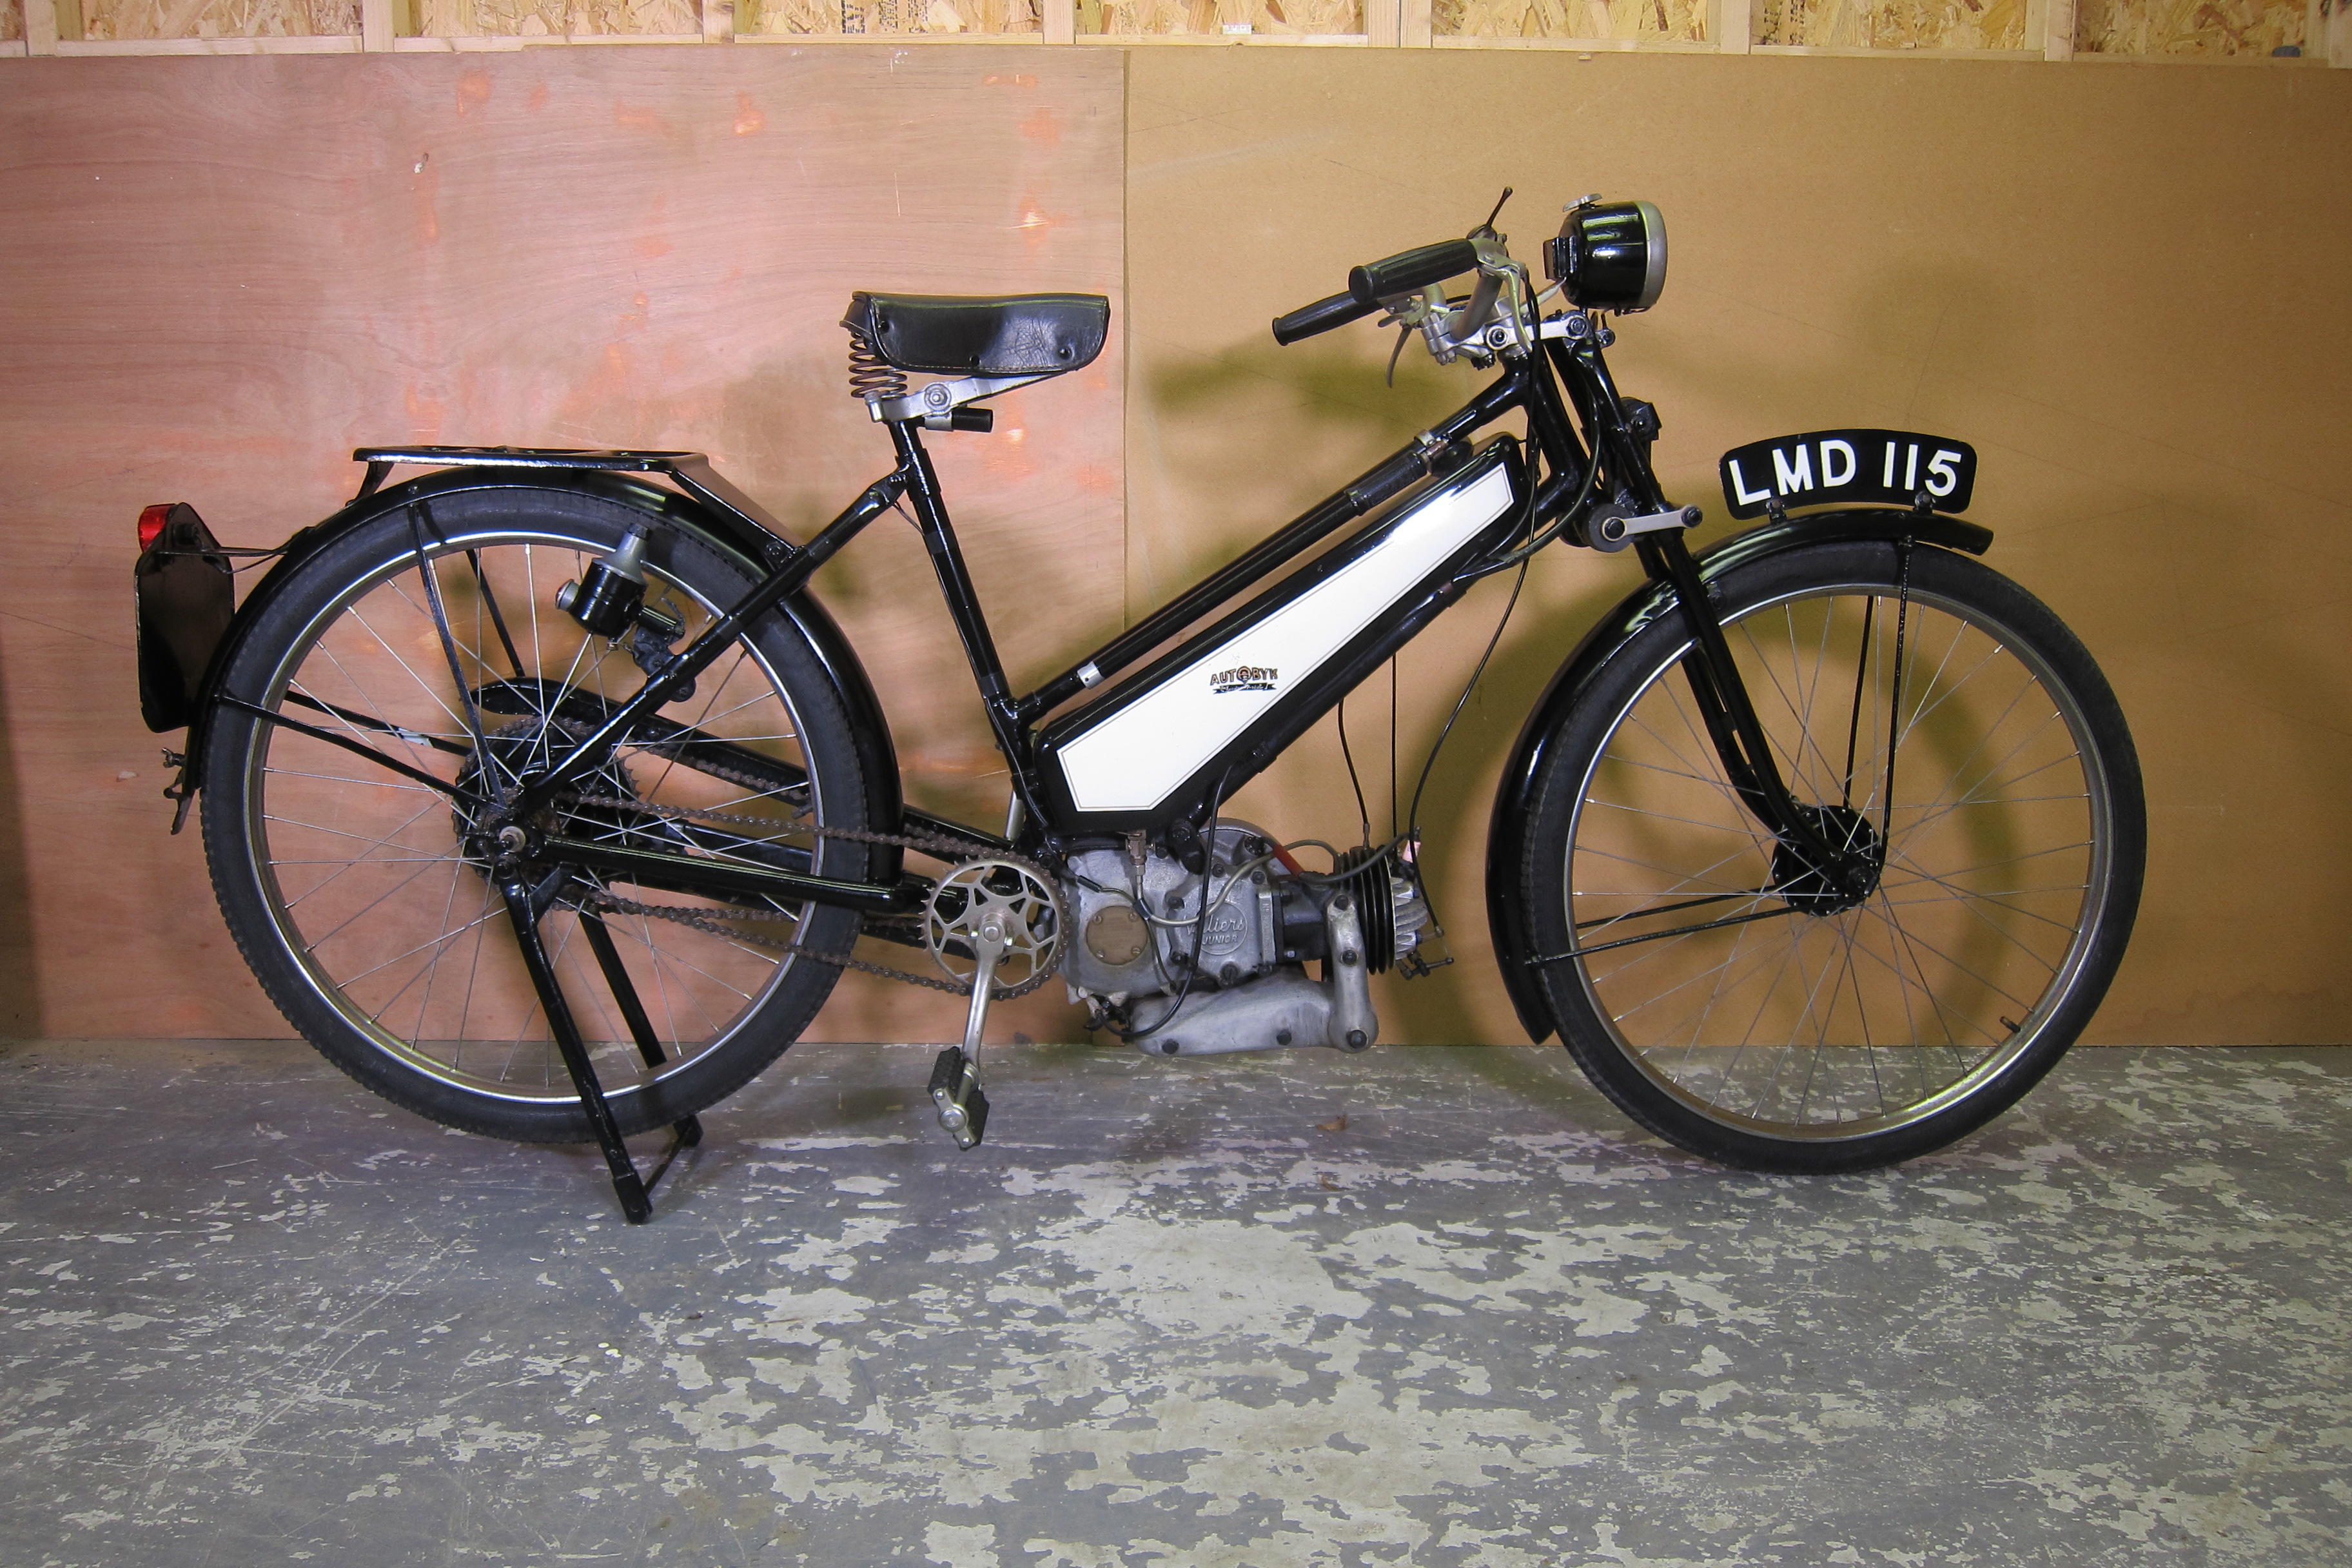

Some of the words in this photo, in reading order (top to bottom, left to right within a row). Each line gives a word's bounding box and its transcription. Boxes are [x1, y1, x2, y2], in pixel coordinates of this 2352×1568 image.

[1729, 439, 1857, 505] LMD
[1883, 441, 1962, 496] 115
[1210, 665, 1278, 685] AUTOBYK
[1187, 914, 1244, 935] Vliers
[1202, 935, 1237, 945] JUNIOR
